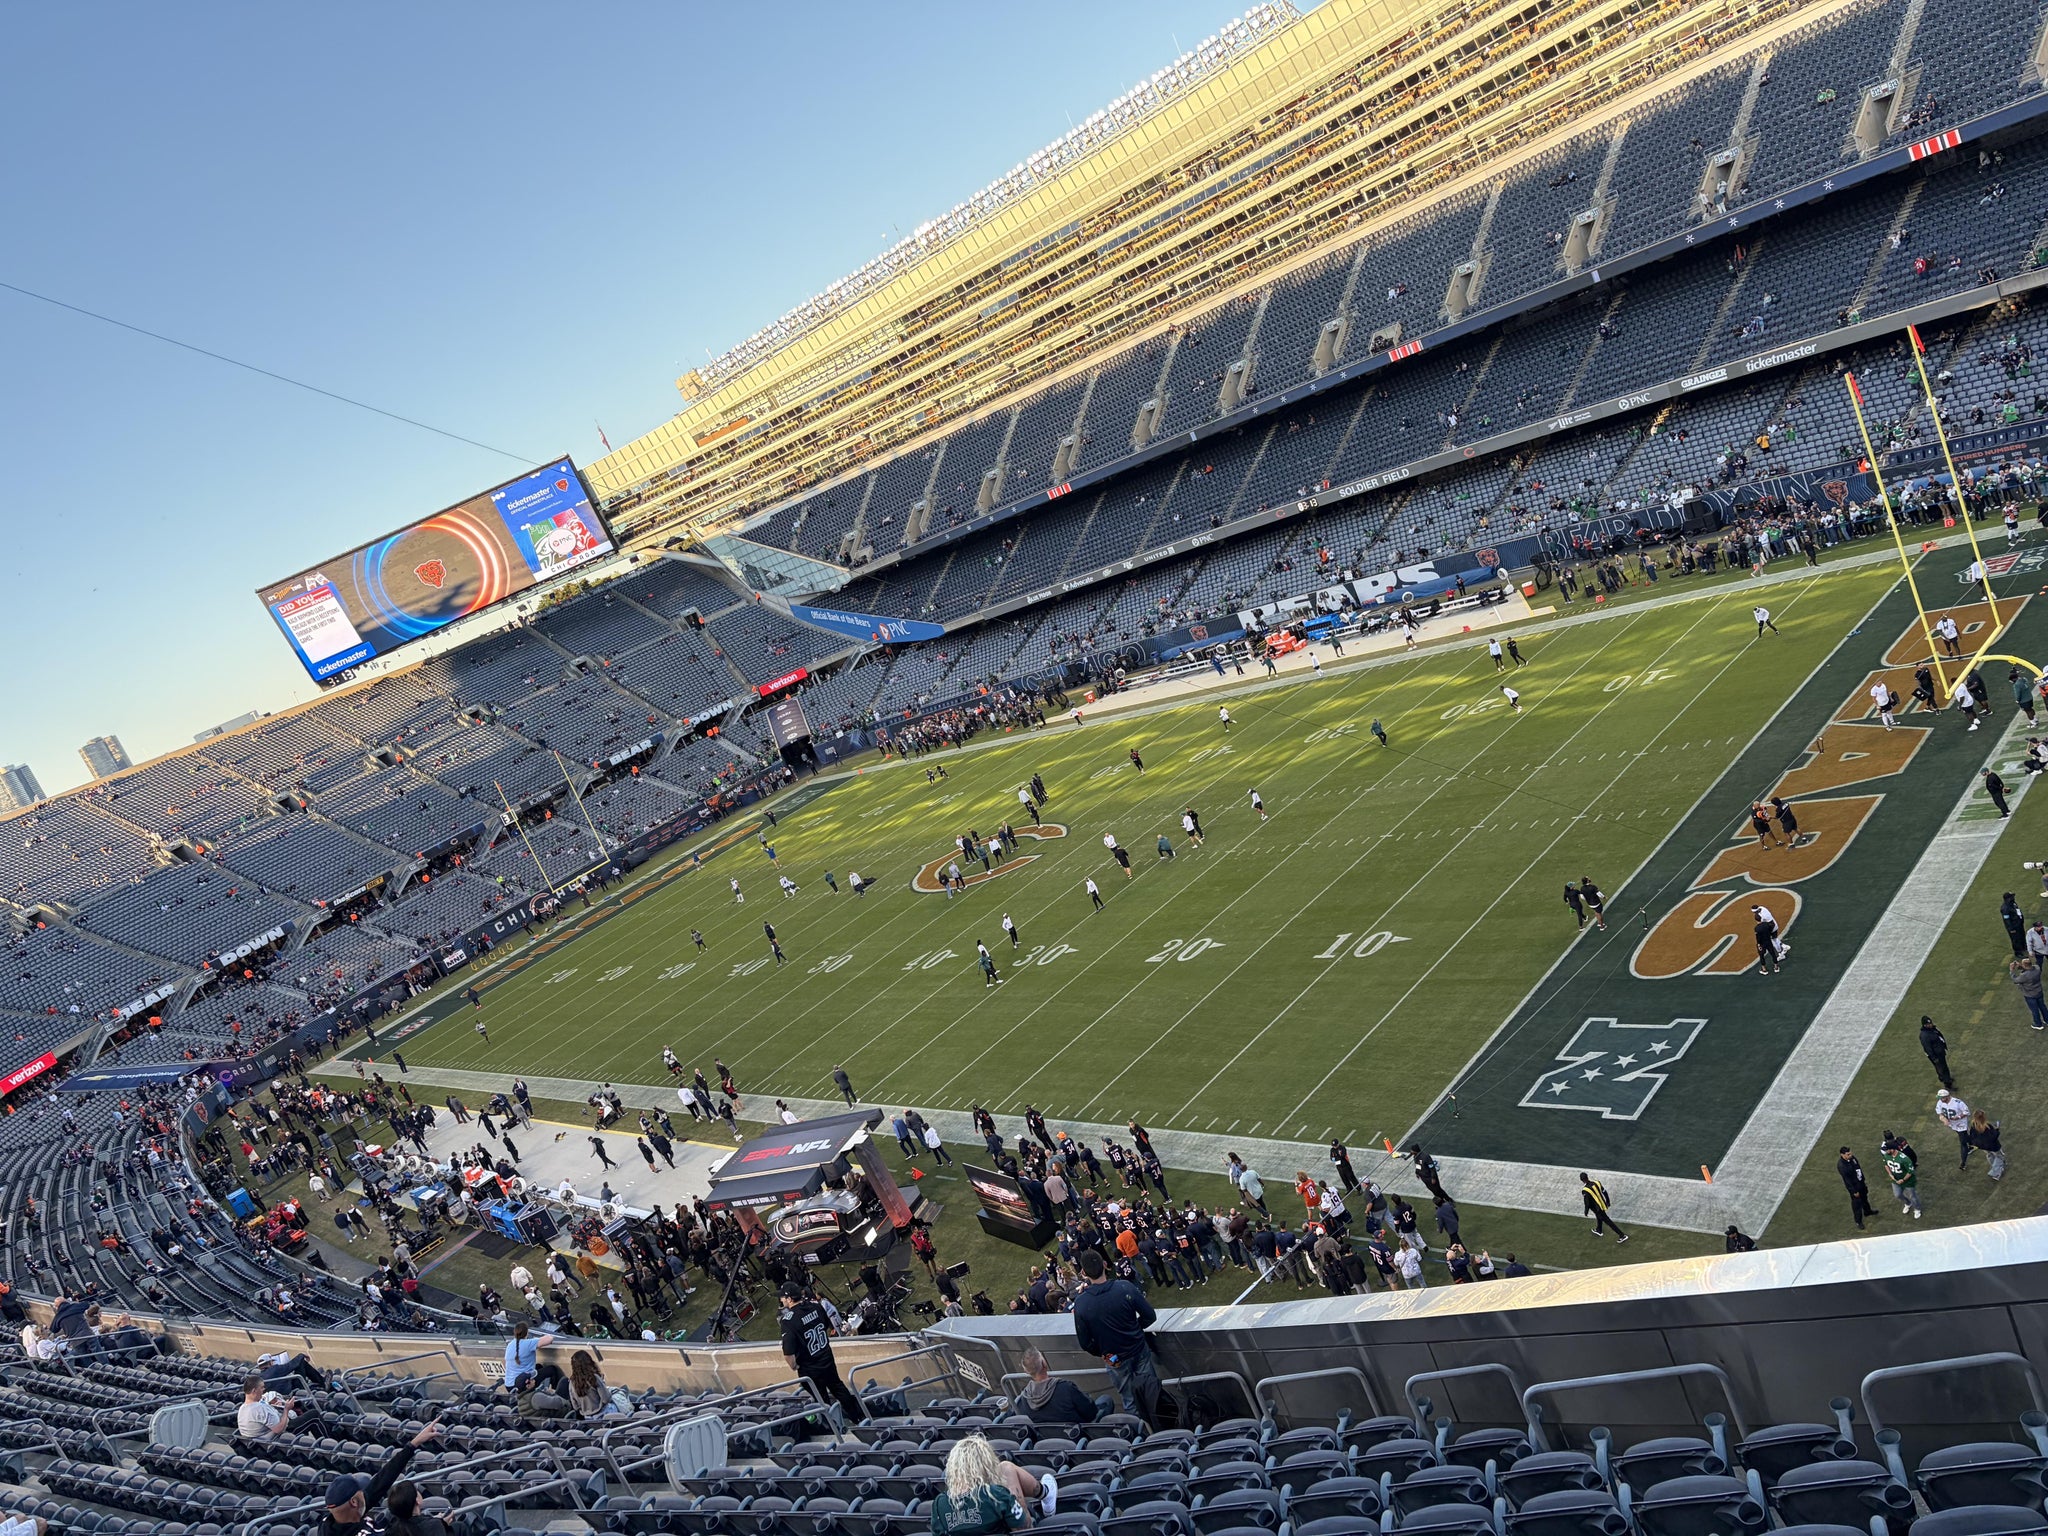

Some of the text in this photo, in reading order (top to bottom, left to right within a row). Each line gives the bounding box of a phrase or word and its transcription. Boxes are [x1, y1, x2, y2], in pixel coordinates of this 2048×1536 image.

[1746, 342, 1817, 373] ticketmaster
[1681, 368, 1727, 390] GRAINGER
[1630, 392, 1652, 407] PNC
[1985, 443, 2027, 456] NUMBERS
[1339, 468, 1410, 498] SOLDIER FIELD
[507, 487, 551, 511] ticketmaster
[1199, 533, 1215, 545] PNC
[1143, 550, 1168, 563] UNITED
[1069, 576, 1094, 590] Advocate
[279, 594, 314, 614] DID YOU
[311, 592, 332, 605] KNOW
[811, 611, 827, 620] Official
[827, 613, 841, 623] Bank
[855, 617, 871, 628] Bears
[890, 621, 911, 638] PNC
[317, 649, 367, 675] ticketmaster
[768, 672, 798, 692] verizon
[689, 700, 735, 726] DOWN
[333, 885, 367, 906] theScore
[220, 926, 285, 966] DOWN
[1012, 944, 1069, 967] 30
[1145, 937, 1214, 963] 20
[1313, 931, 1394, 960] 10
[446, 953, 466, 968] MNF
[808, 953, 854, 974] 50
[902, 949, 953, 971] 40
[119, 984, 176, 1020] BEAR
[8, 1059, 45, 1086] verizon
[741, 1139, 832, 1163] ESPN NFL
[1066, 1143, 1075, 1155] 34
[1112, 1151, 1121, 1162] 18
[1151, 1165, 1162, 1180] 34
[1306, 1184, 1316, 1199] 18
[1330, 1193, 1341, 1207] 19
[1122, 1219, 1137, 1230] 52
[1402, 1210, 1413, 1223] 12
[1369, 1251, 1384, 1266] 76
[803, 1322, 828, 1356] 26
[480, 1362, 494, 1373] 332
[945, 1507, 982, 1531] EAGLES
